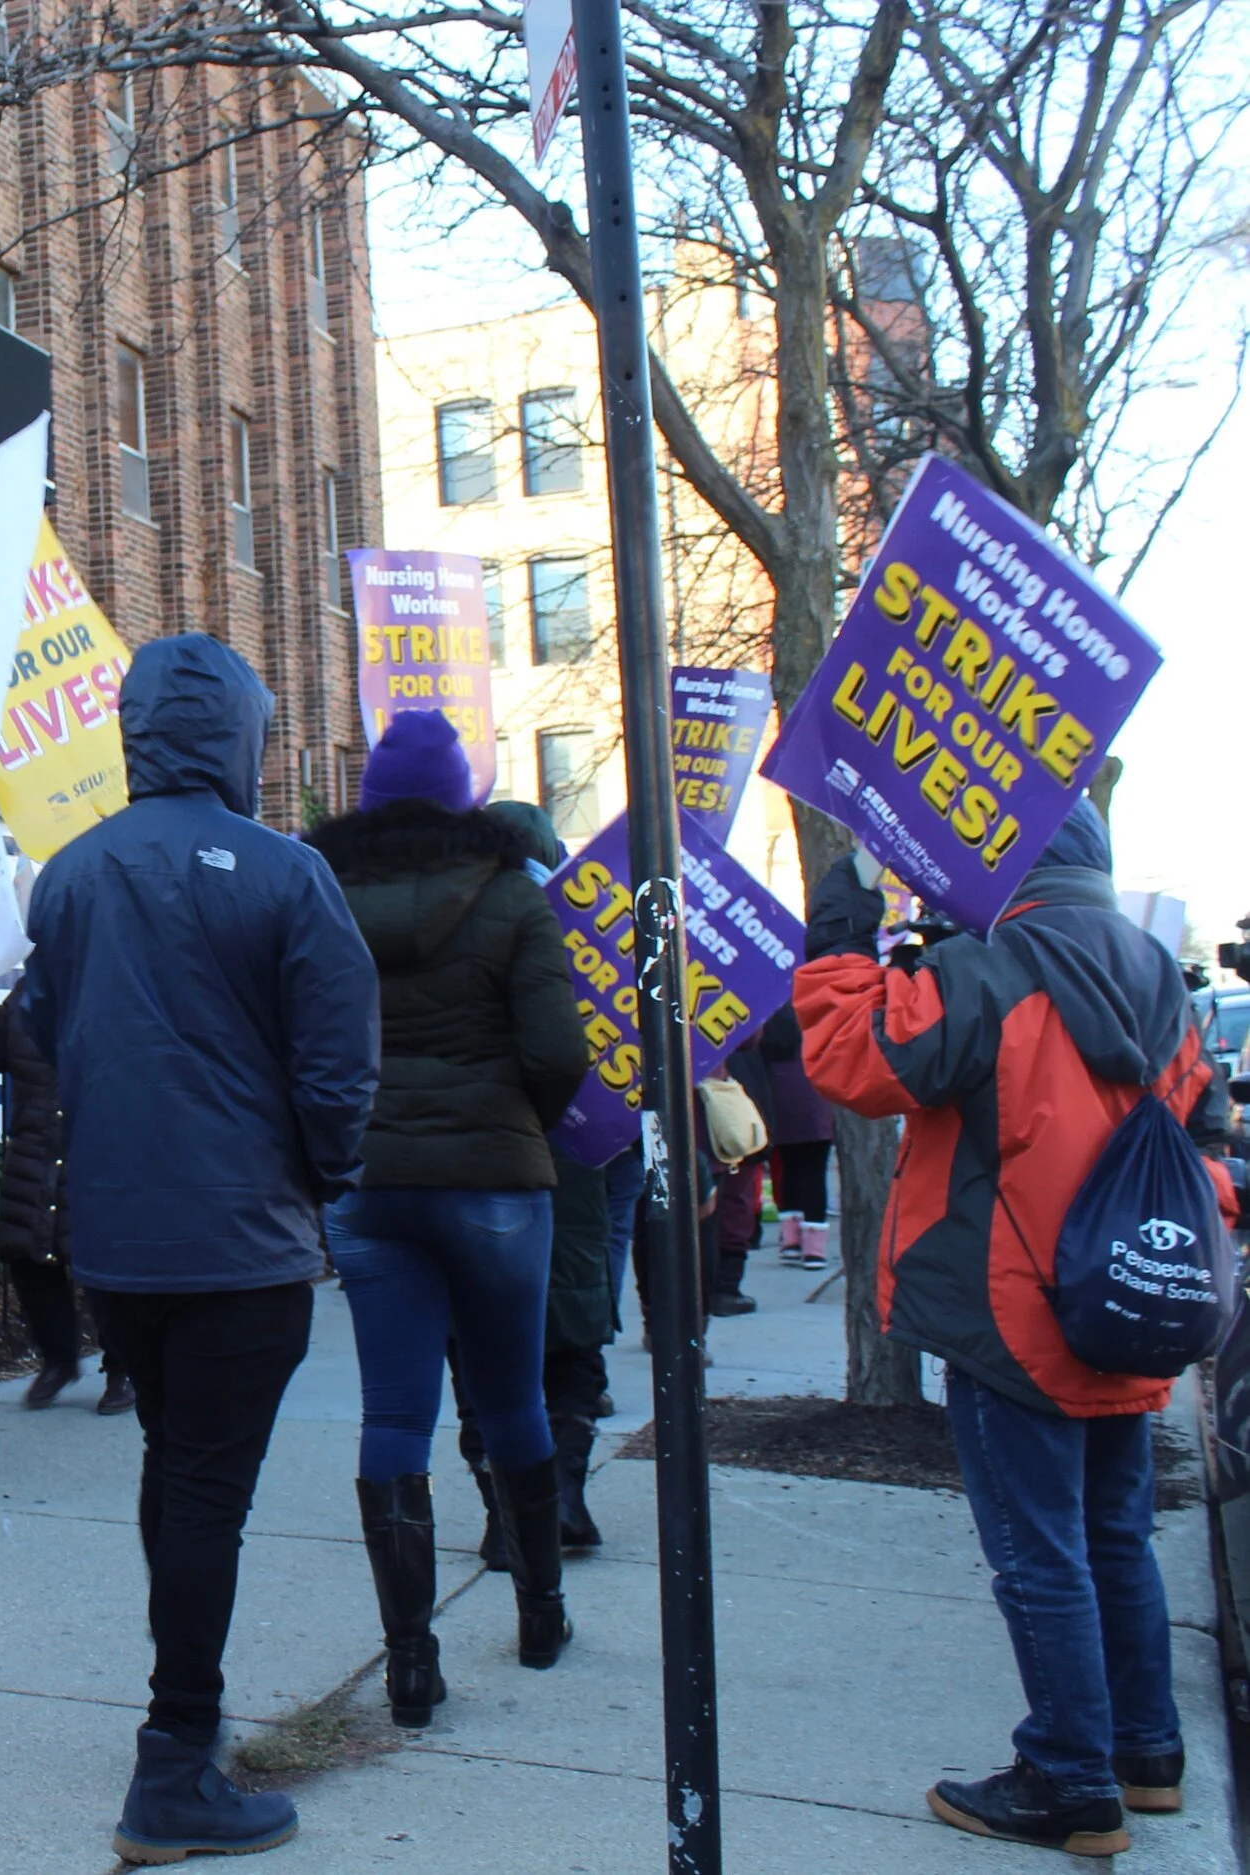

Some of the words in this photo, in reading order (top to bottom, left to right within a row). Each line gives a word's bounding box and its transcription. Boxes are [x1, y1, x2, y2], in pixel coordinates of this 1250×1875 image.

[365, 565, 436, 591] Nursing
[437, 566, 474, 590] Home
[929, 490, 1048, 608] Nursing
[1040, 587, 1130, 681] Home
[391, 593, 460, 616] Workers
[955, 559, 1071, 679] Workers
[41, 624, 95, 666] OUR
[363, 624, 486, 666] STRIKE
[388, 675, 433, 699] FOR
[437, 675, 474, 698] OUR
[674, 676, 722, 698] Nursing
[721, 680, 765, 701] Home
[873, 561, 1097, 789] STRIKE
[685, 697, 738, 717] Workers
[886, 646, 954, 725] FOR
[952, 713, 1023, 793] OUR
[673, 719, 756, 754] TRIKE
[692, 755, 728, 777] OUR
[832, 662, 1021, 873] LIVES!
[675, 778, 732, 813] VES!
[725, 897, 795, 970] Home
[561, 861, 750, 1049] STKE
[563, 928, 620, 994] FOR
